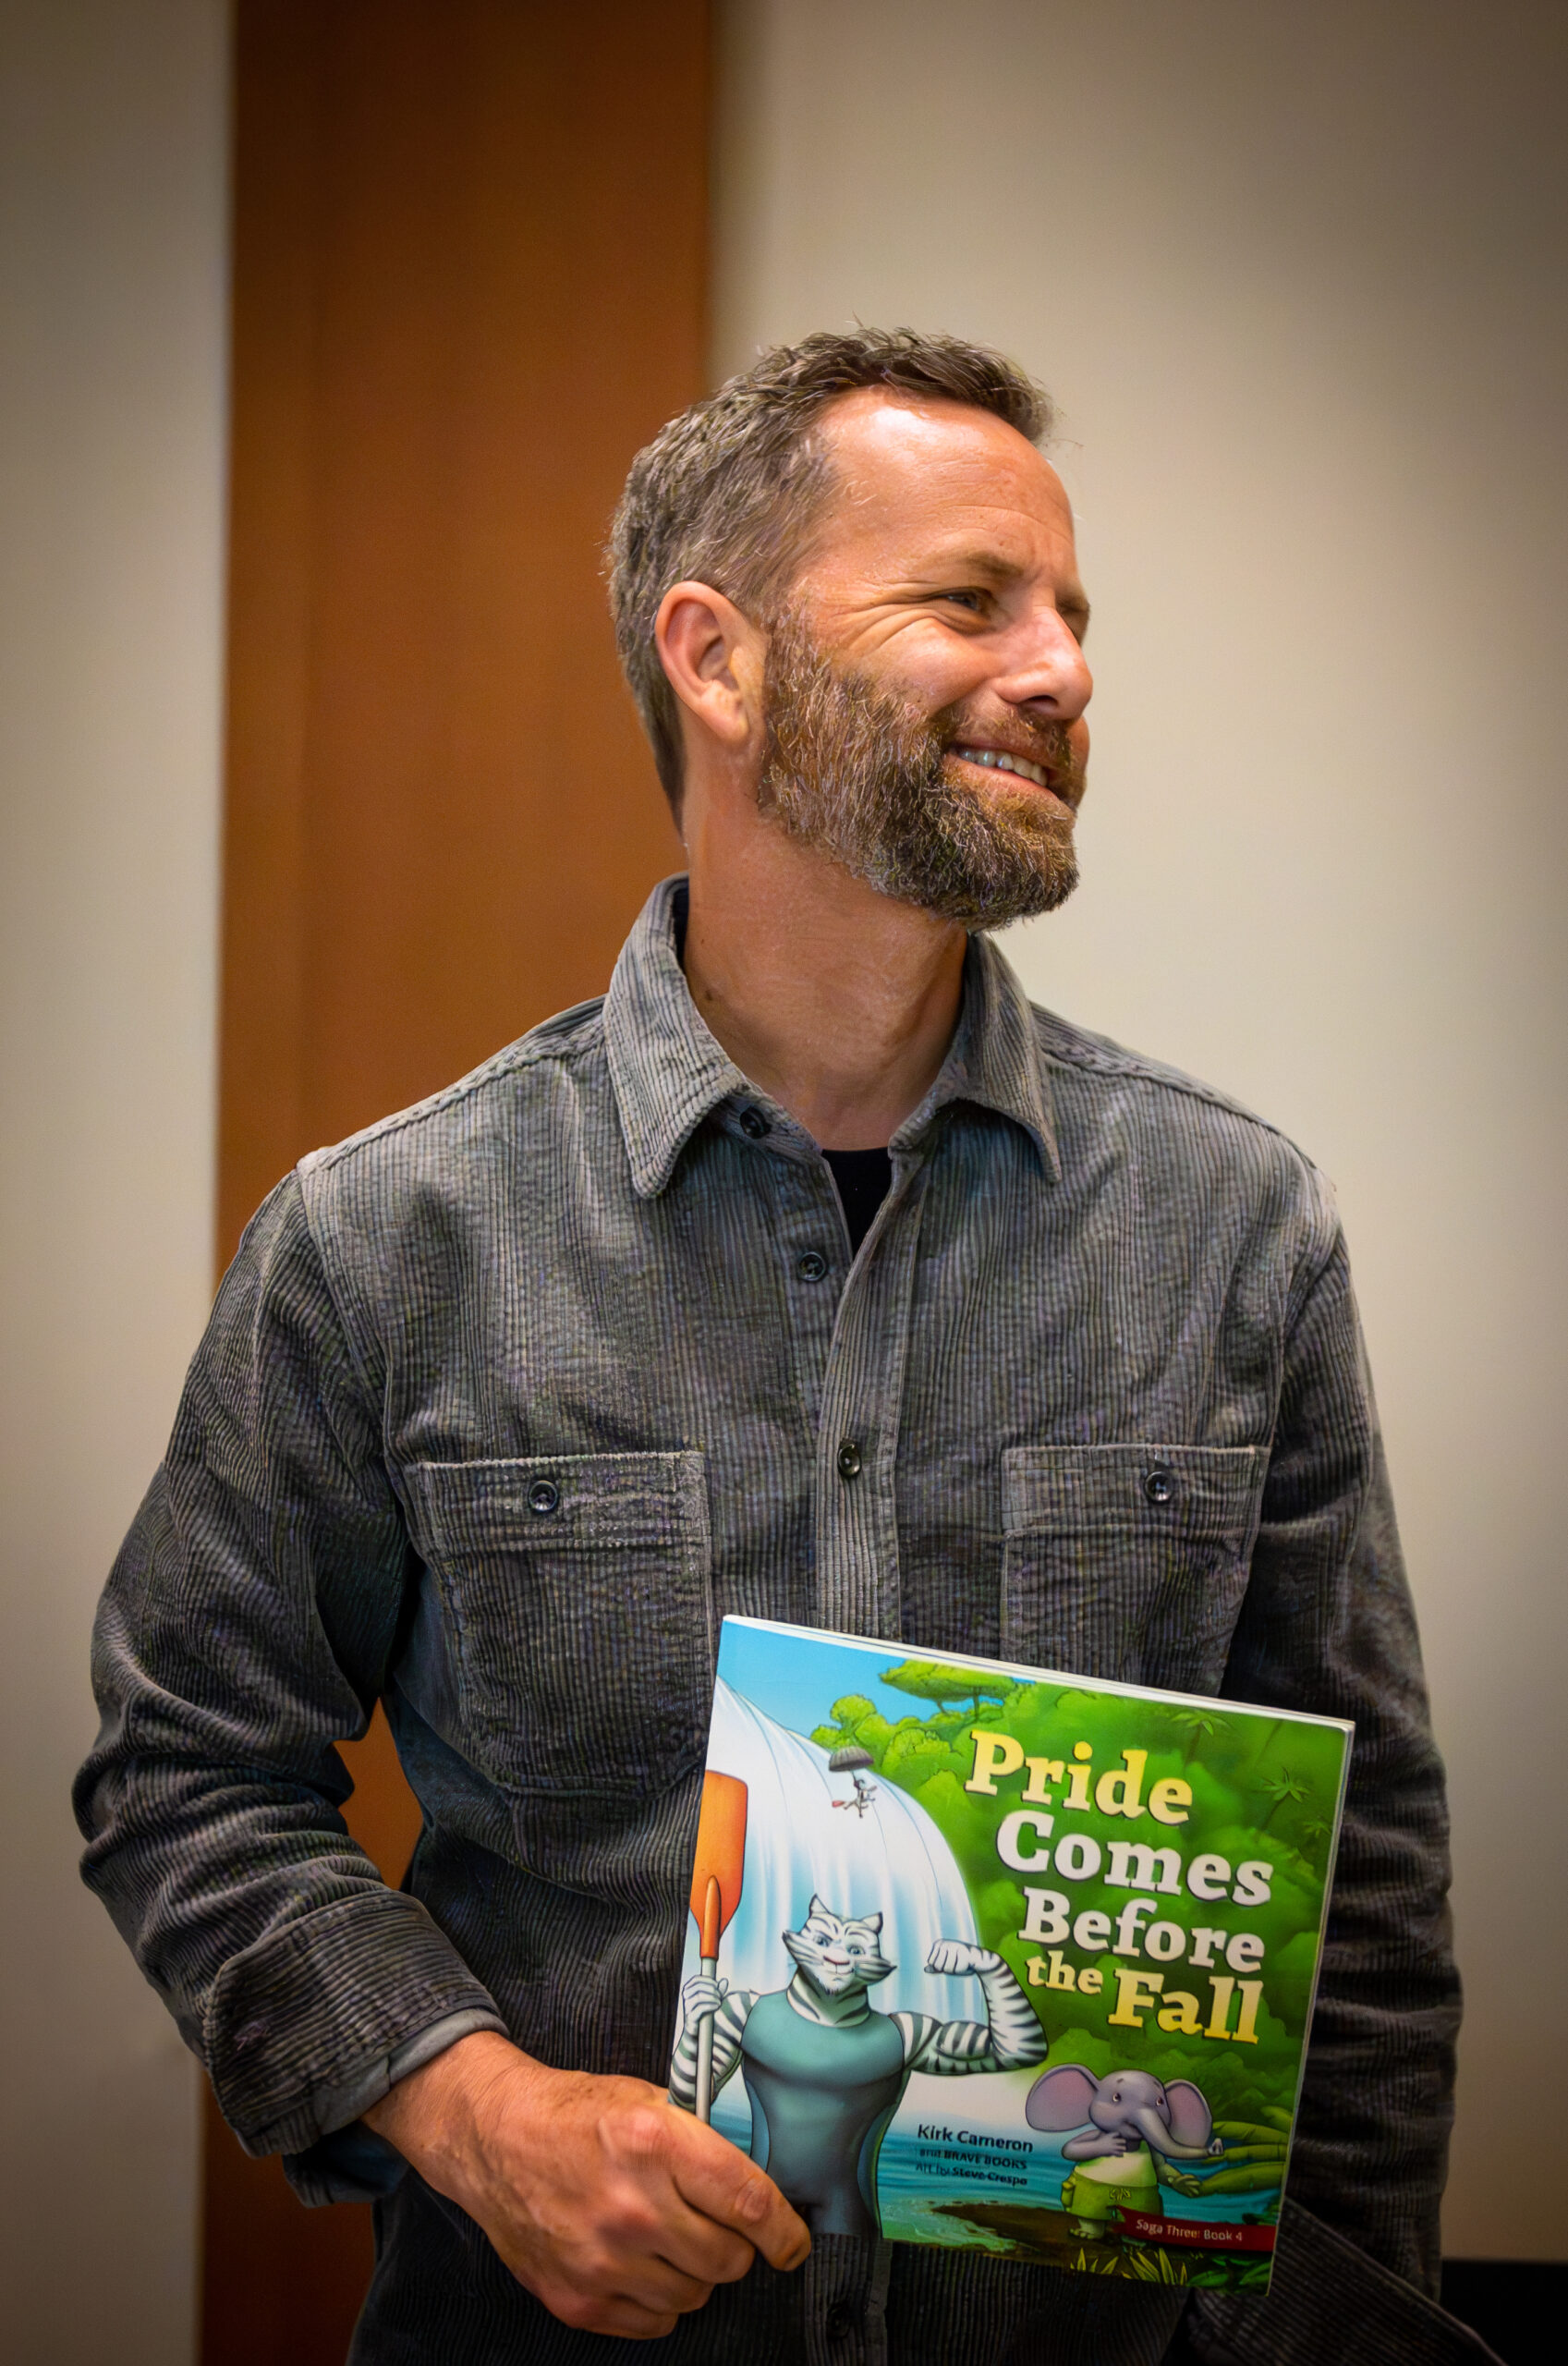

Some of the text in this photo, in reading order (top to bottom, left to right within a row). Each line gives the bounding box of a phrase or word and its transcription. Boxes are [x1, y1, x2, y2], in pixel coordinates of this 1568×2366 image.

[965, 1729, 1193, 1825] Pride
[996, 1810, 1274, 1907] Comes
[1018, 1886, 1266, 1973] Before
[1026, 1950, 1264, 2044] the Fall
[918, 2124, 1033, 2153] Kirk Cameron
[943, 2149, 980, 2165] BRAVE
[984, 2153, 1027, 2170] BOOKS
[916, 2162, 1028, 2187] Art by Steve Crespo
[1136, 2219, 1163, 2235] Saga
[1203, 2229, 1233, 2241] Book
[1235, 2232, 1243, 2241] 4
